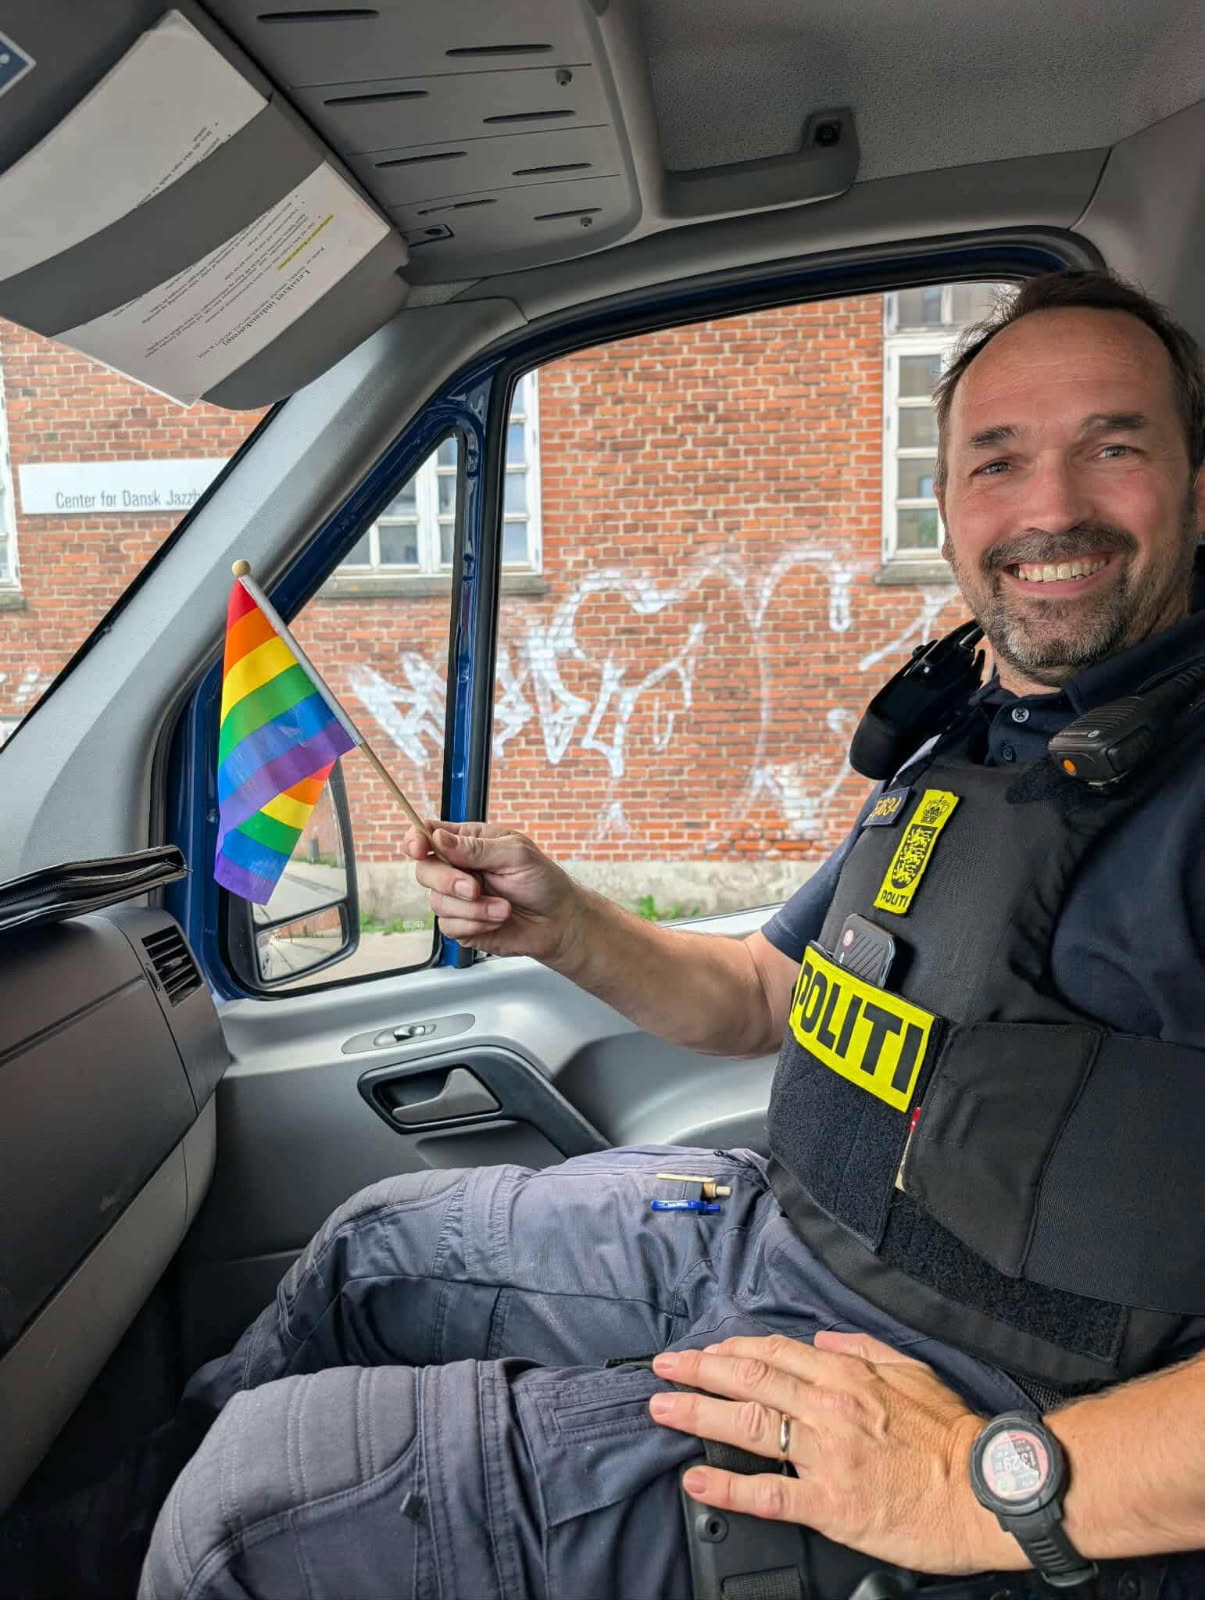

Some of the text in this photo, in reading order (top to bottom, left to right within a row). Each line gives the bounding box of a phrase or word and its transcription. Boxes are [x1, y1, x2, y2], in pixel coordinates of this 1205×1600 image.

[56, 491, 95, 509] Center
[101, 490, 117, 508] for
[123, 488, 161, 507] Dansk
[880, 890, 909, 907] POLITI
[793, 960, 925, 1095] POLITI
